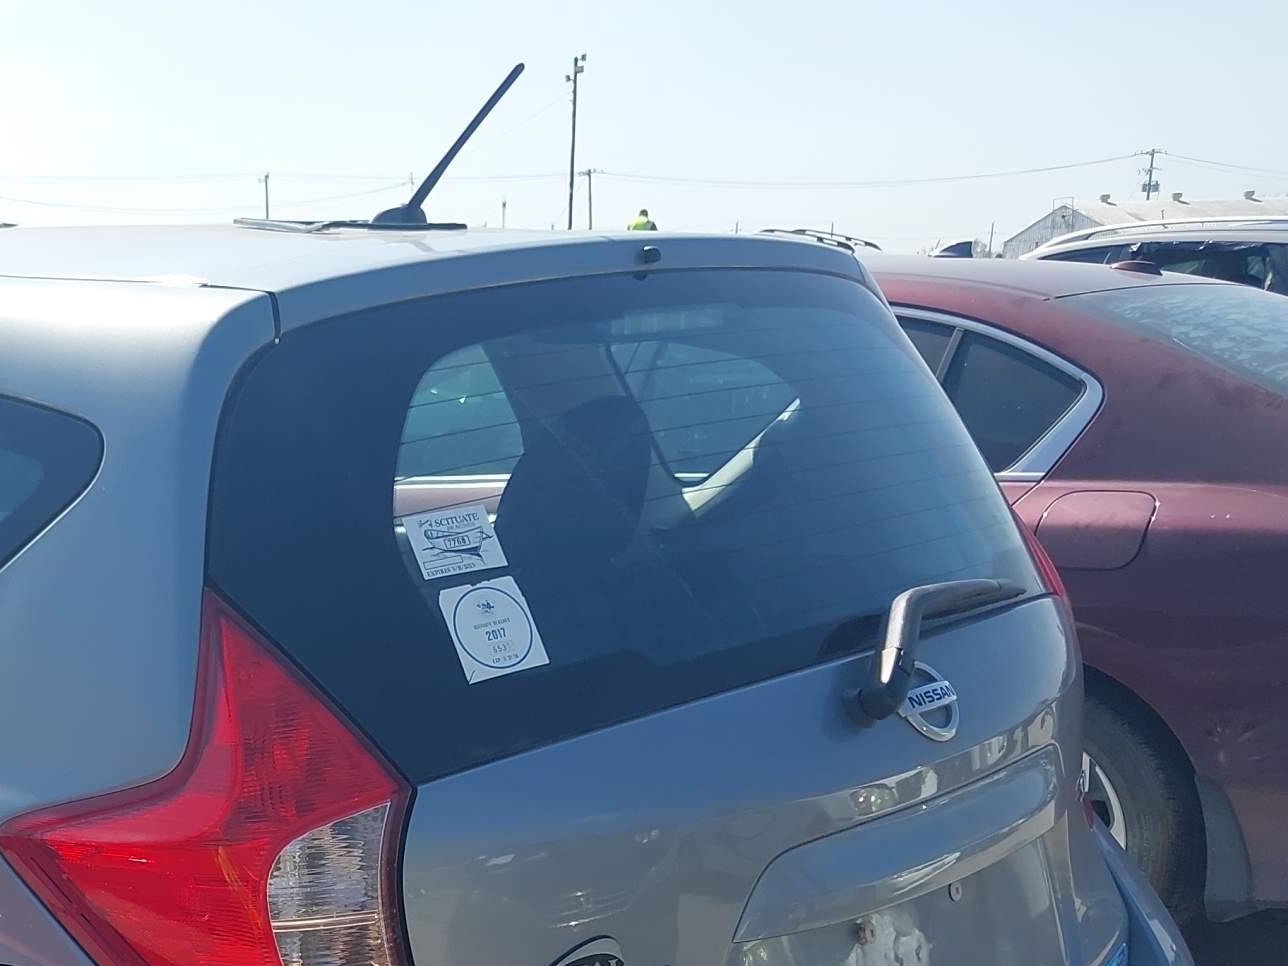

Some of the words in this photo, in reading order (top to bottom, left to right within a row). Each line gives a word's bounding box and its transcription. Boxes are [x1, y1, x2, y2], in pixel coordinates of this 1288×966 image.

[434, 512, 479, 528] SCITUATE
[485, 627, 506, 641] 2017
[907, 684, 954, 709] NISSAN
